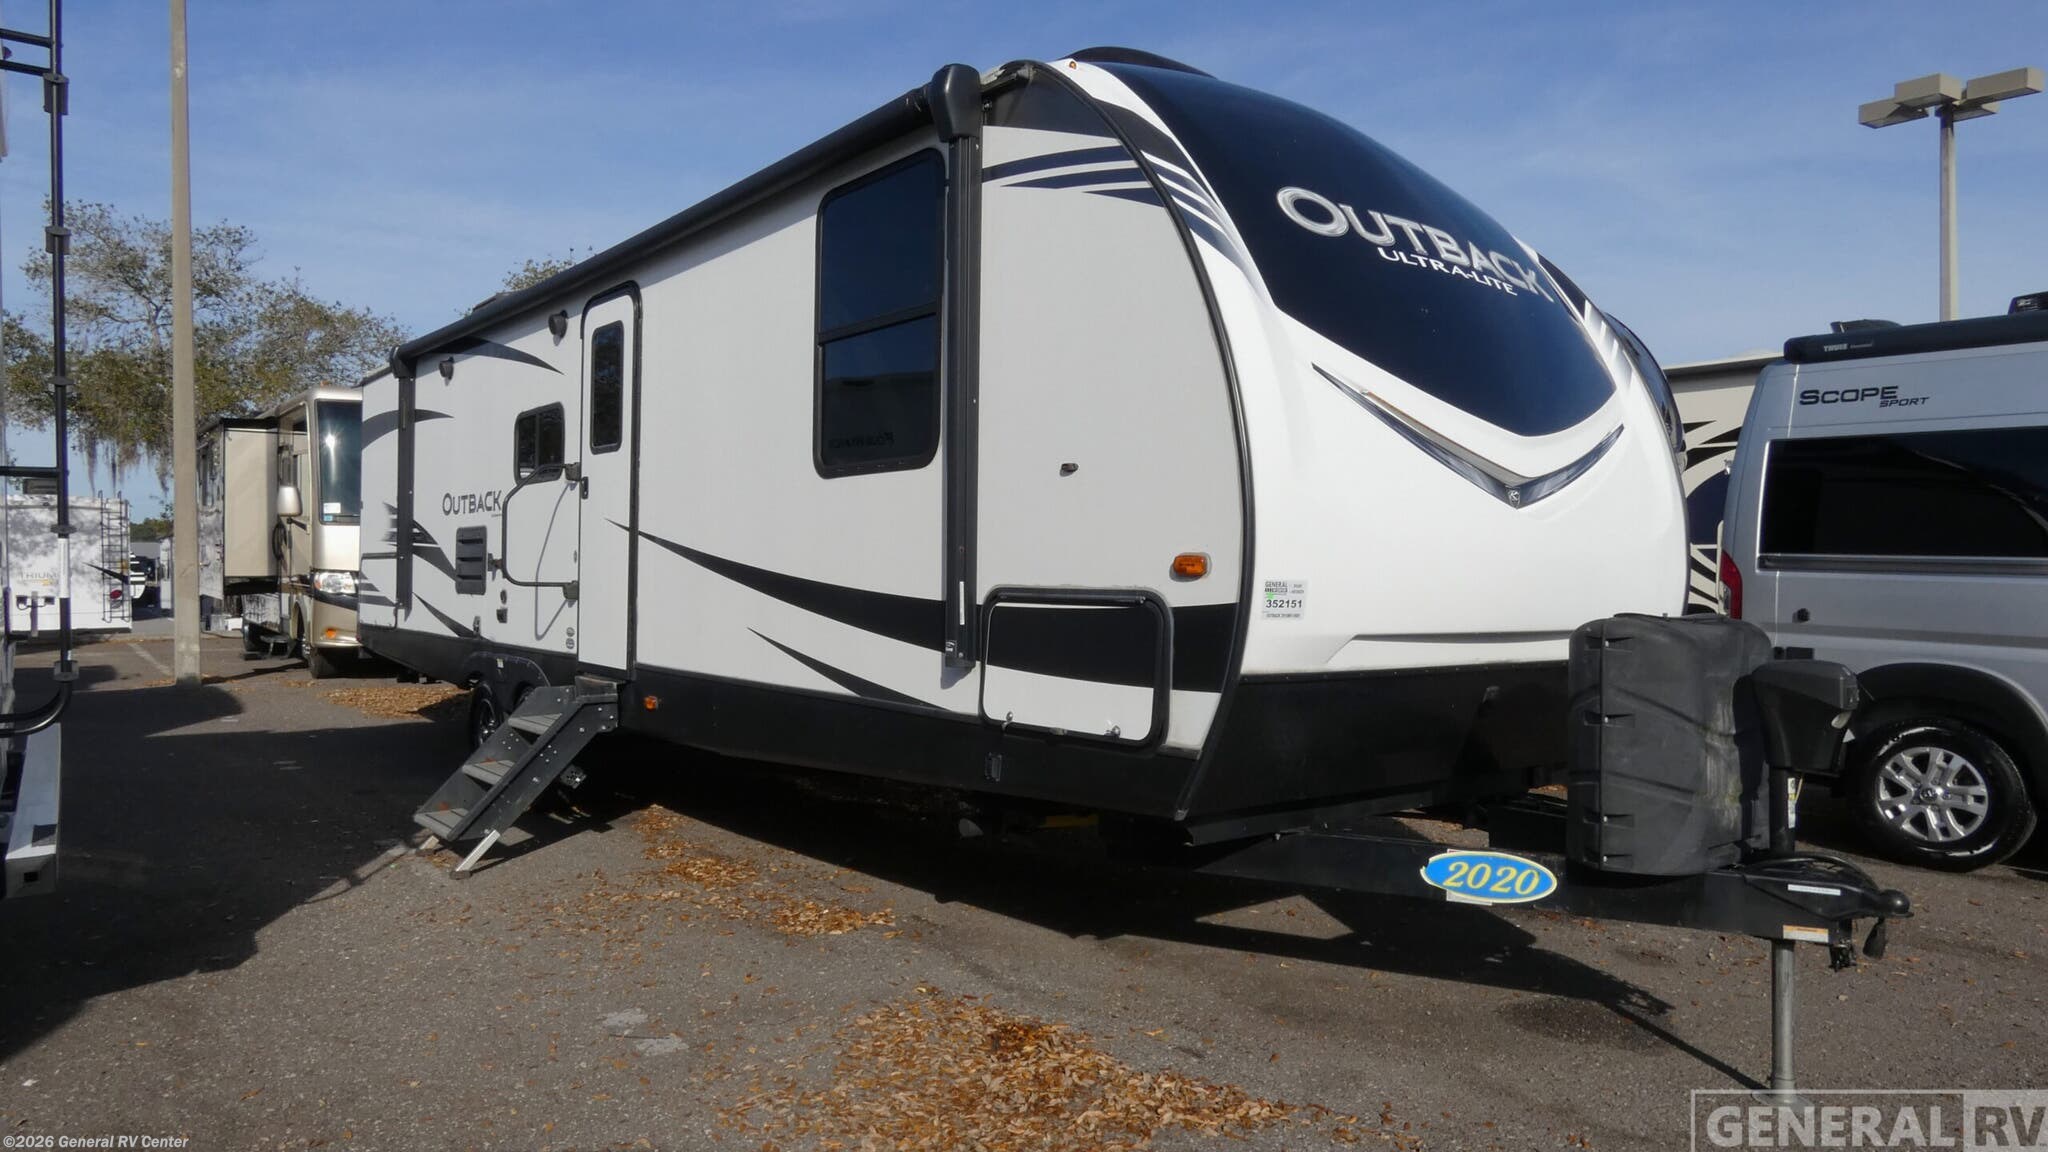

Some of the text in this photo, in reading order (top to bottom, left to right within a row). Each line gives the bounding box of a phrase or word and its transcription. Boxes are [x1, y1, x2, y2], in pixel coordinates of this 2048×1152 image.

[1276, 186, 1554, 302] OUTBACK
[1377, 247, 1518, 296] ULTRA-LITE
[1799, 385, 1899, 406] SCOPE
[1878, 397, 1930, 408] SPORT
[442, 490, 502, 516] OUTBACK
[1266, 600, 1302, 608] 352151
[1442, 861, 1540, 895] 2020
